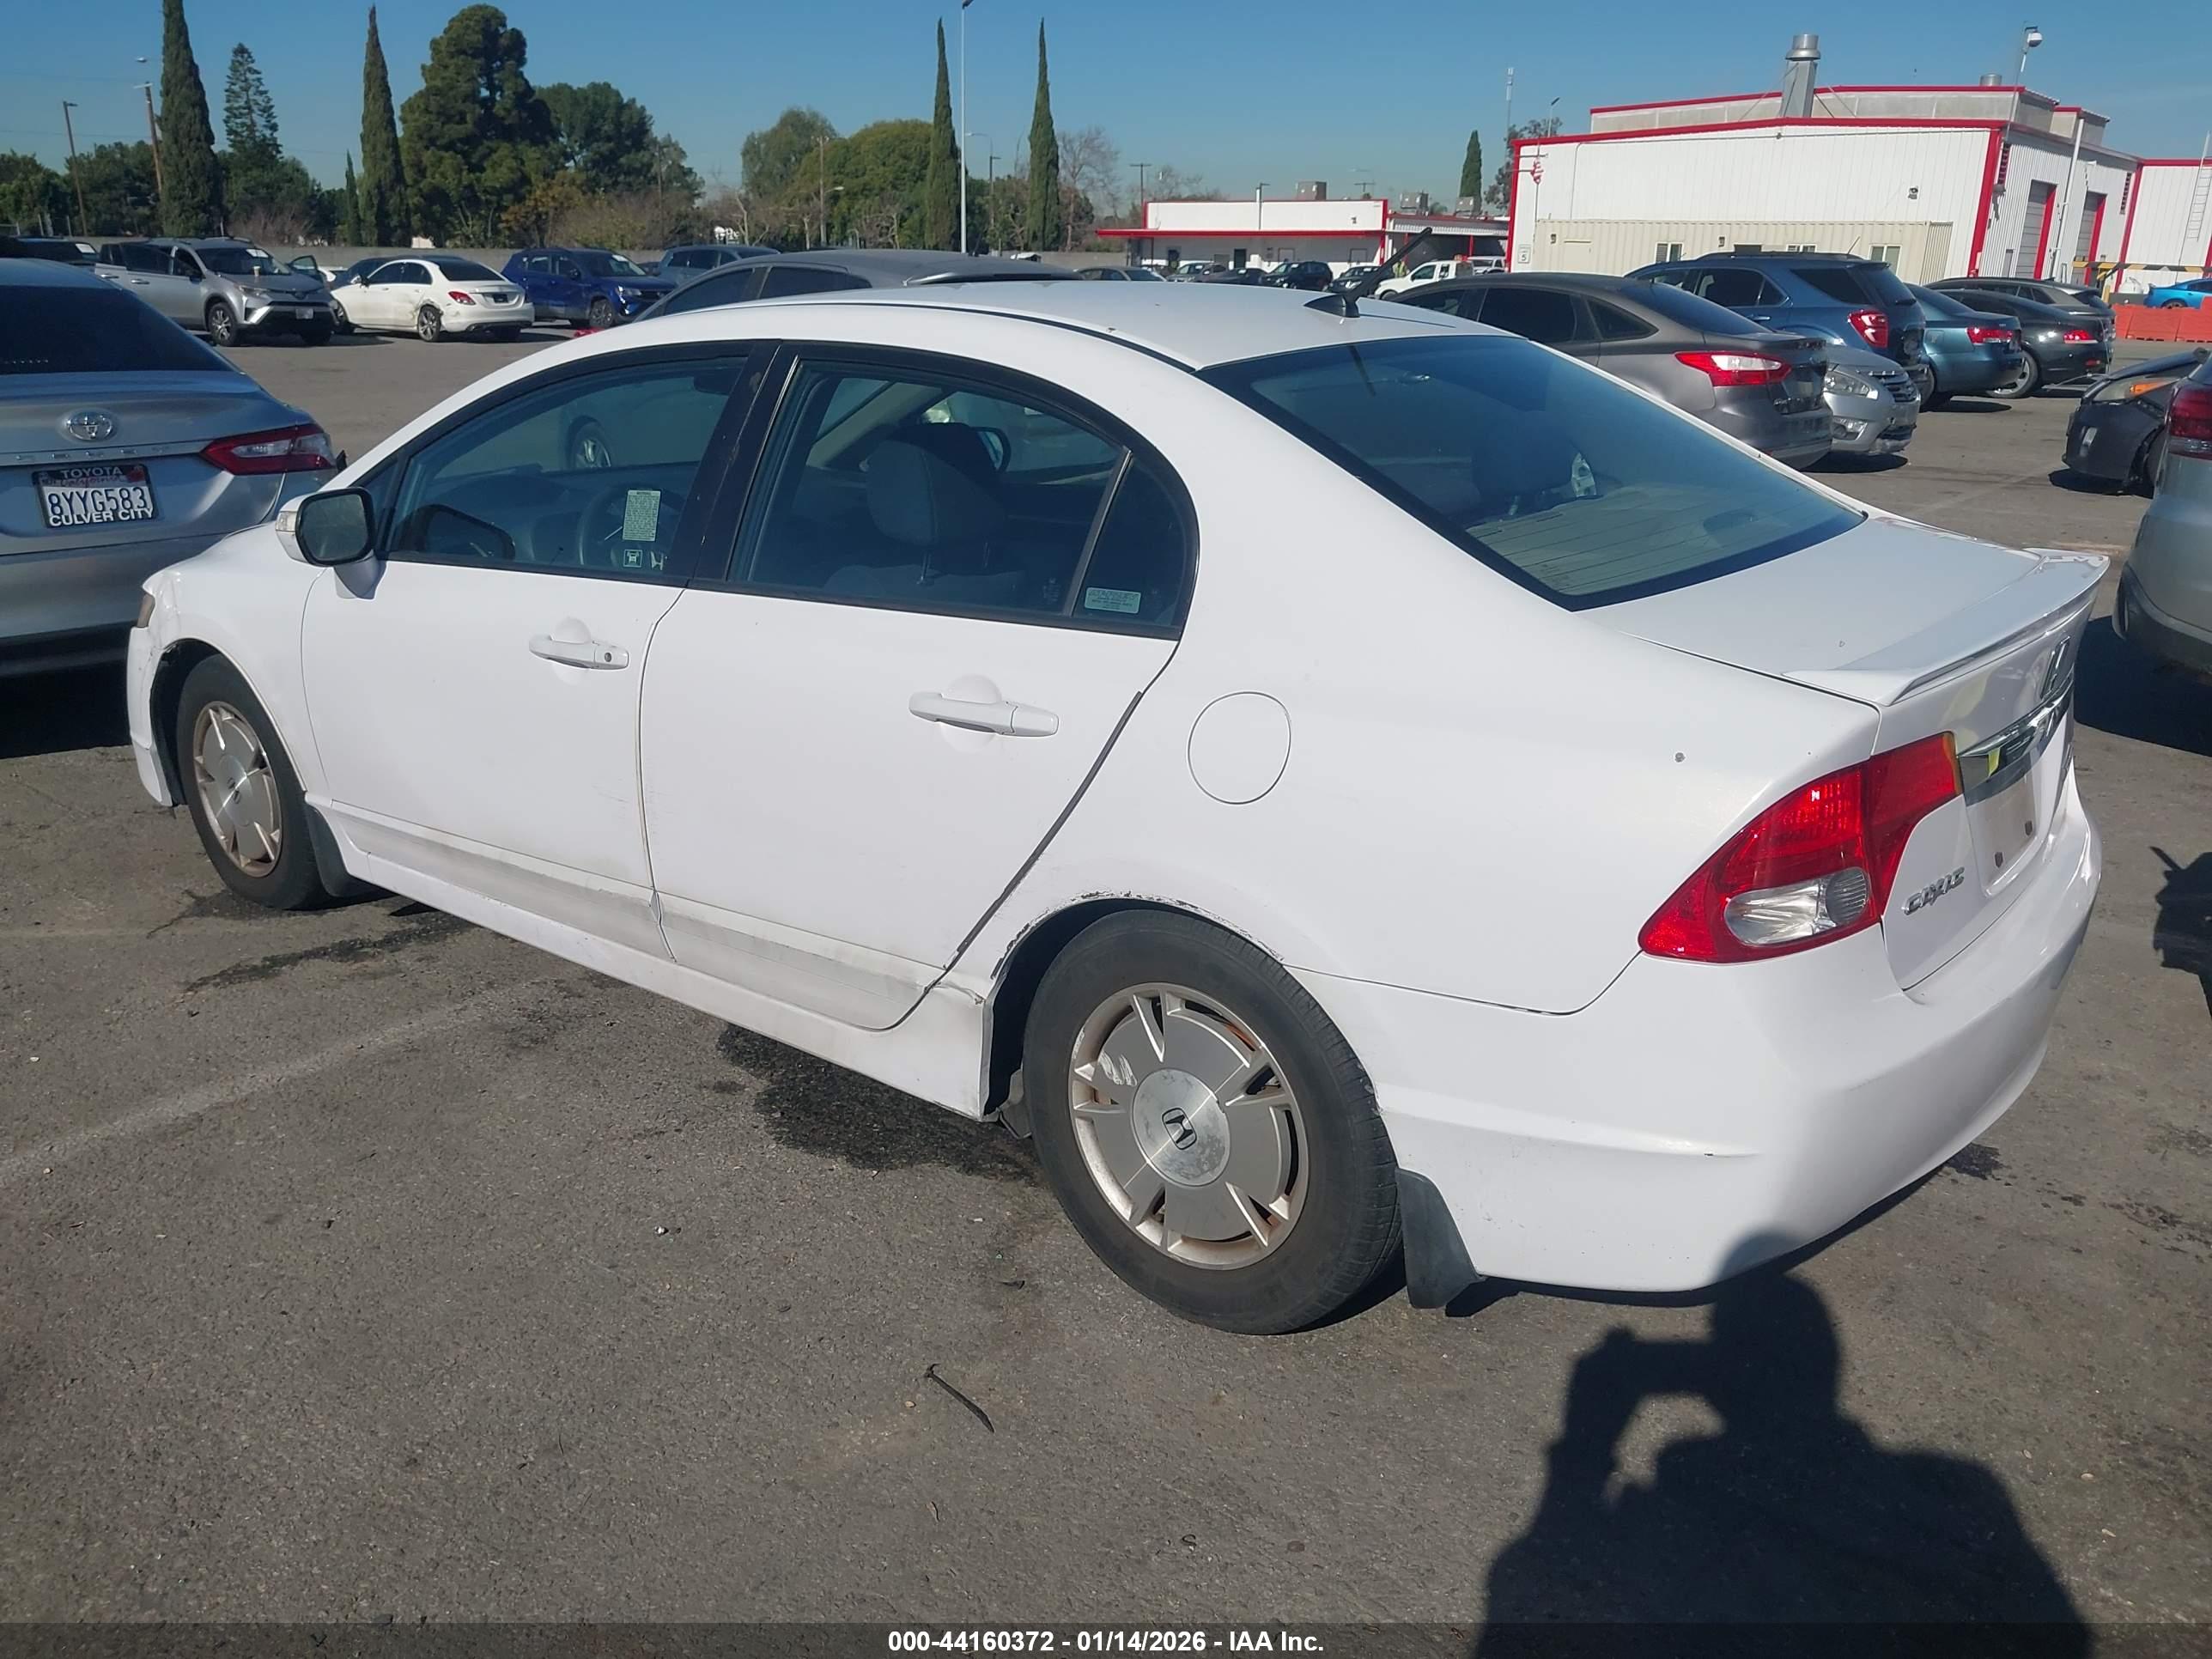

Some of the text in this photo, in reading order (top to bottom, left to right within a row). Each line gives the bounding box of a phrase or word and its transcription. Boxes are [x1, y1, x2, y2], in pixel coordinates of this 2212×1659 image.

[60, 466, 123, 477] TOYOTA
[48, 487, 148, 516] 8YYG583
[49, 507, 154, 527] CULVER CITY
[1903, 866, 1965, 915] CIVIC
